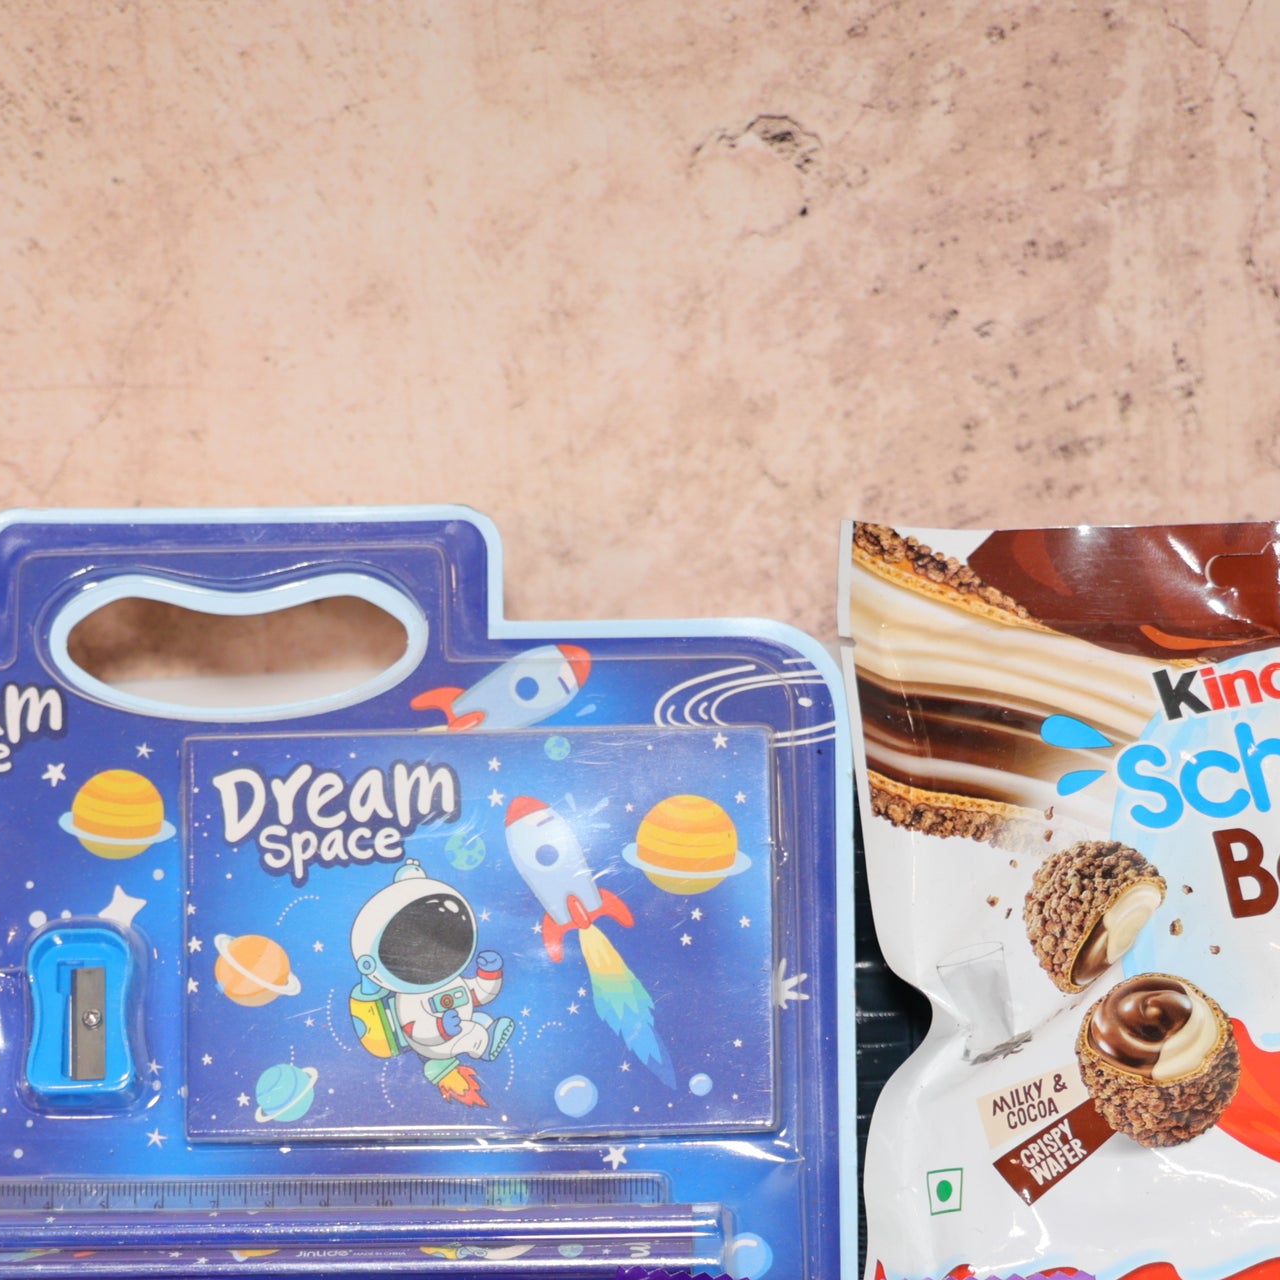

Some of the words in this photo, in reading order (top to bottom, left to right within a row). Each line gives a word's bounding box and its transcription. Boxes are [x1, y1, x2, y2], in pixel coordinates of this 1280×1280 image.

[213, 763, 456, 844] Dream
[992, 1079, 1043, 1116] MILKY
[1053, 1073, 1068, 1093] &
[1007, 1097, 1059, 1129] COCOA
[1020, 1118, 1073, 1168] CRISPY
[1030, 1138, 1087, 1185] WAFER
